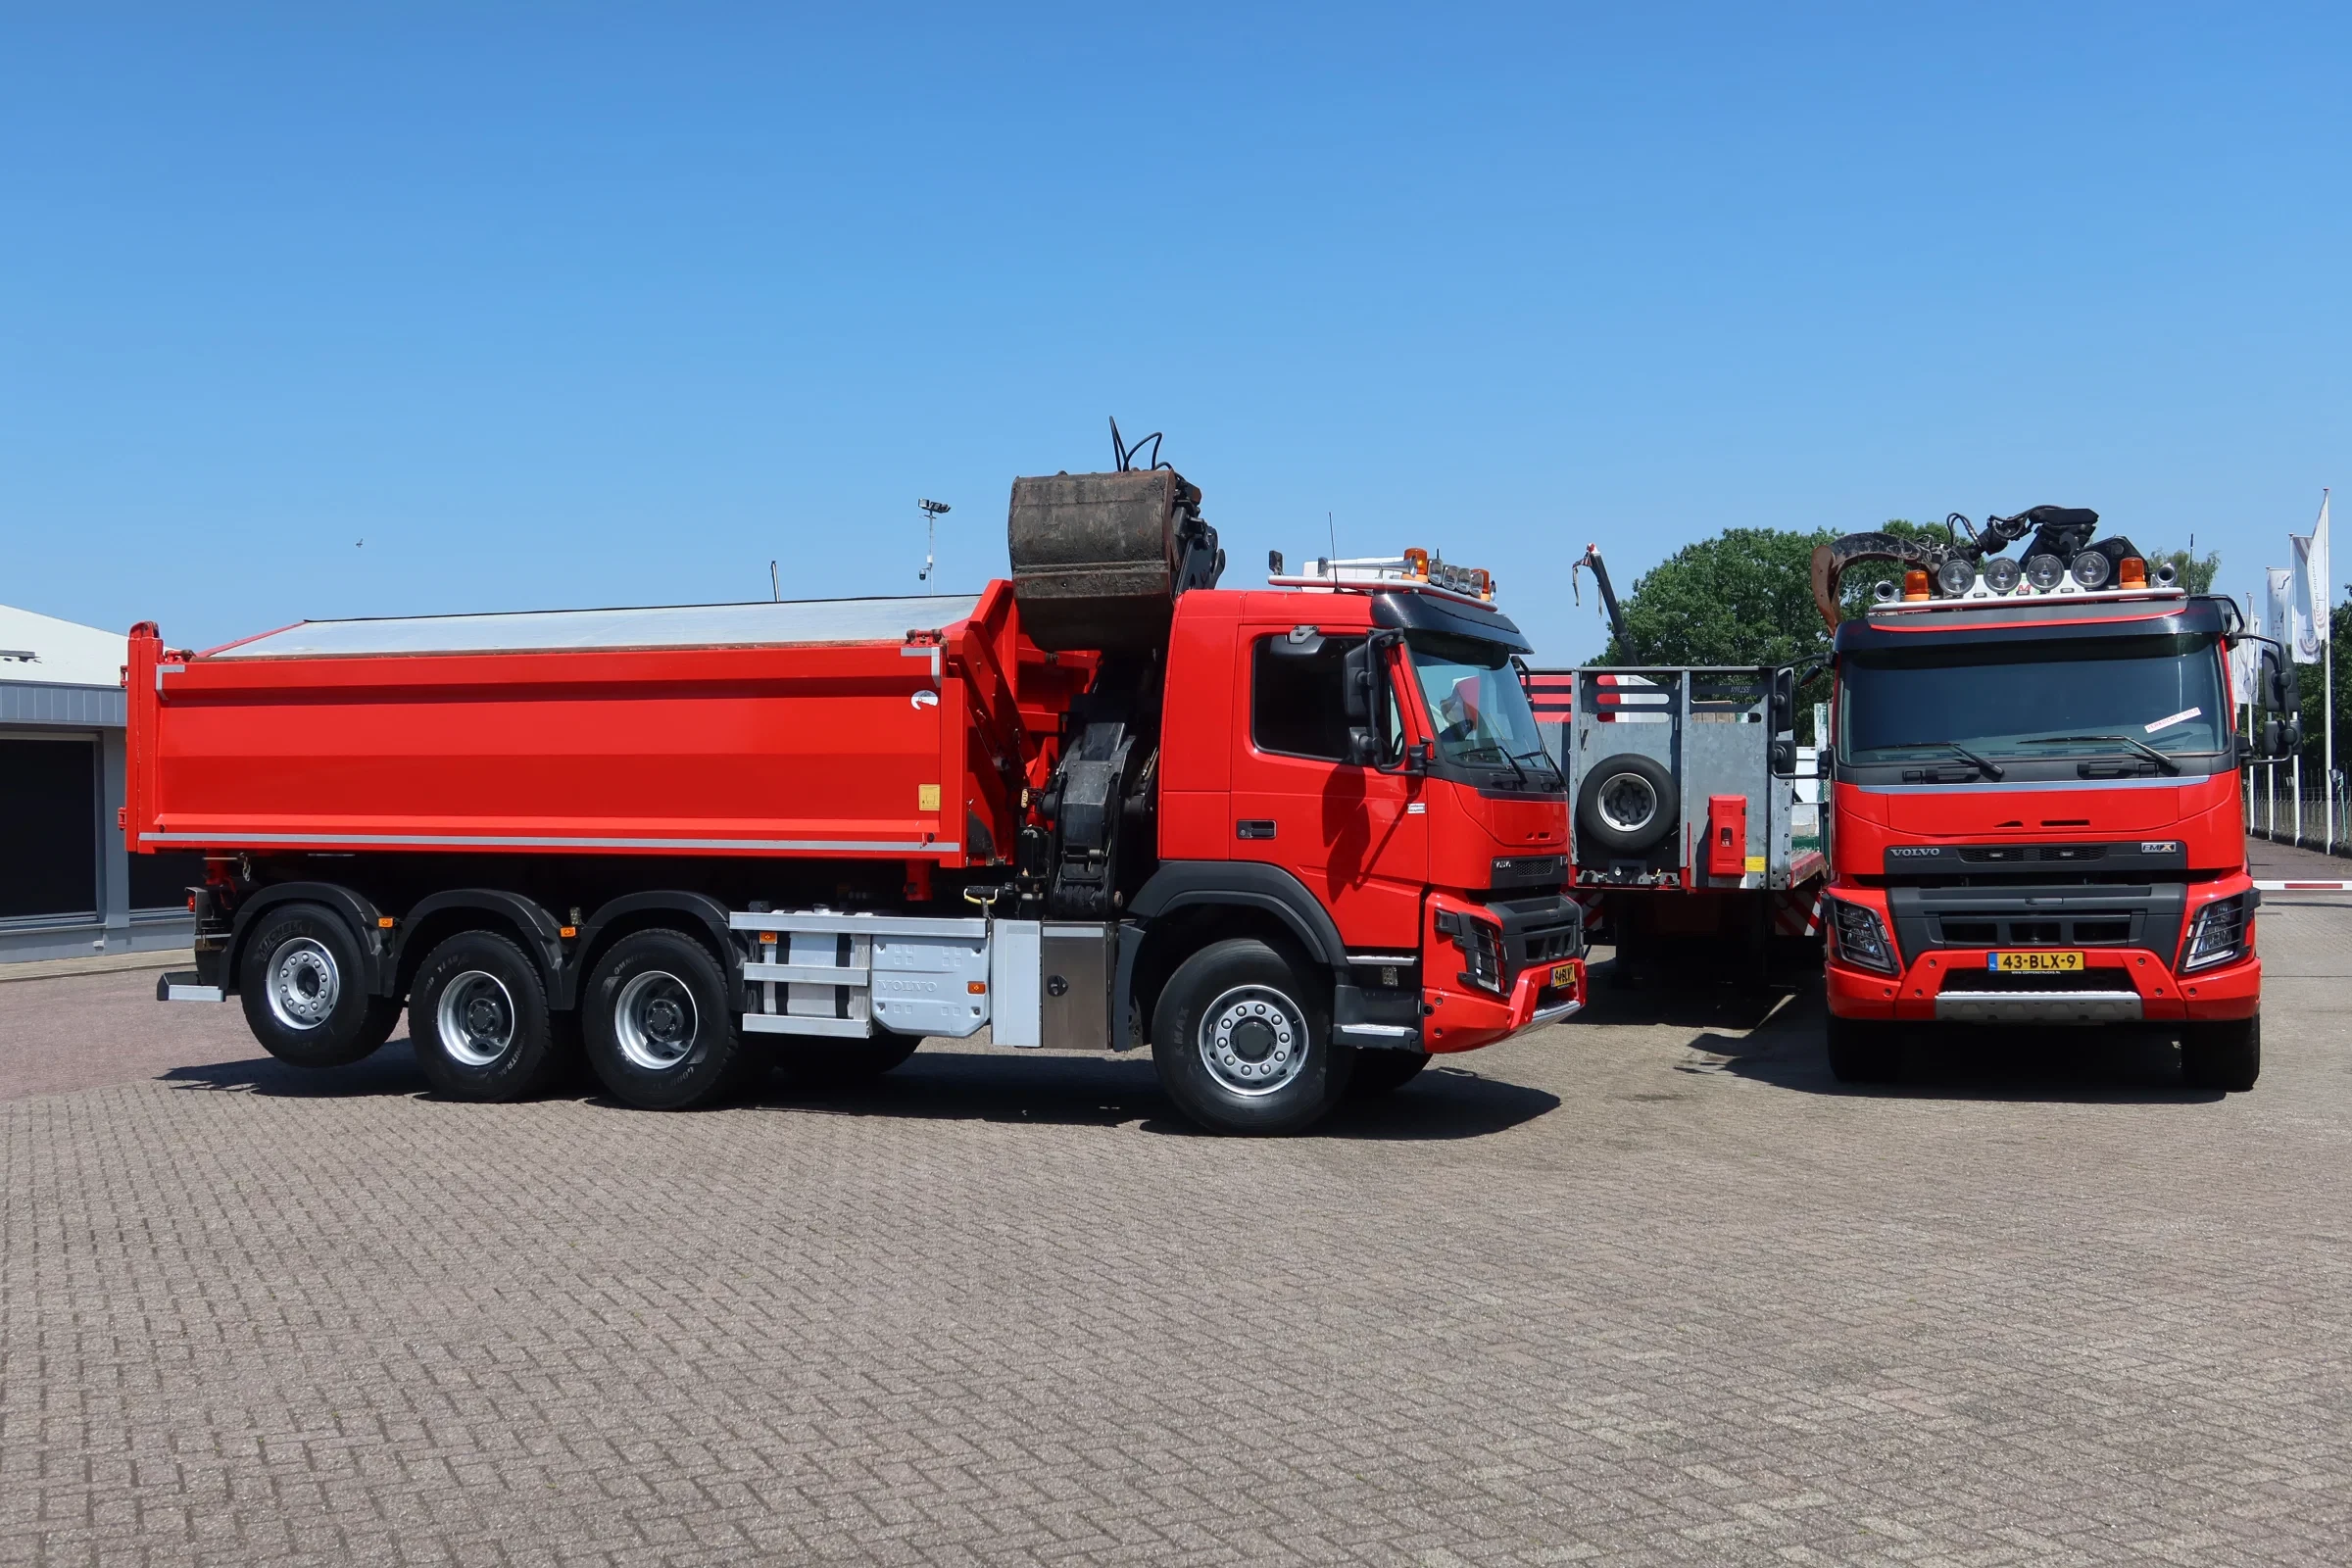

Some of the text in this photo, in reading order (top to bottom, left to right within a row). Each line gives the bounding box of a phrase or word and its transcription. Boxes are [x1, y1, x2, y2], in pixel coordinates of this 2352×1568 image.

[1890, 848, 1940, 857] VOLVO
[2142, 843, 2176, 853] FMX
[2002, 955, 2077, 969] 43-BLX-9
[876, 980, 938, 993] VOLVO
